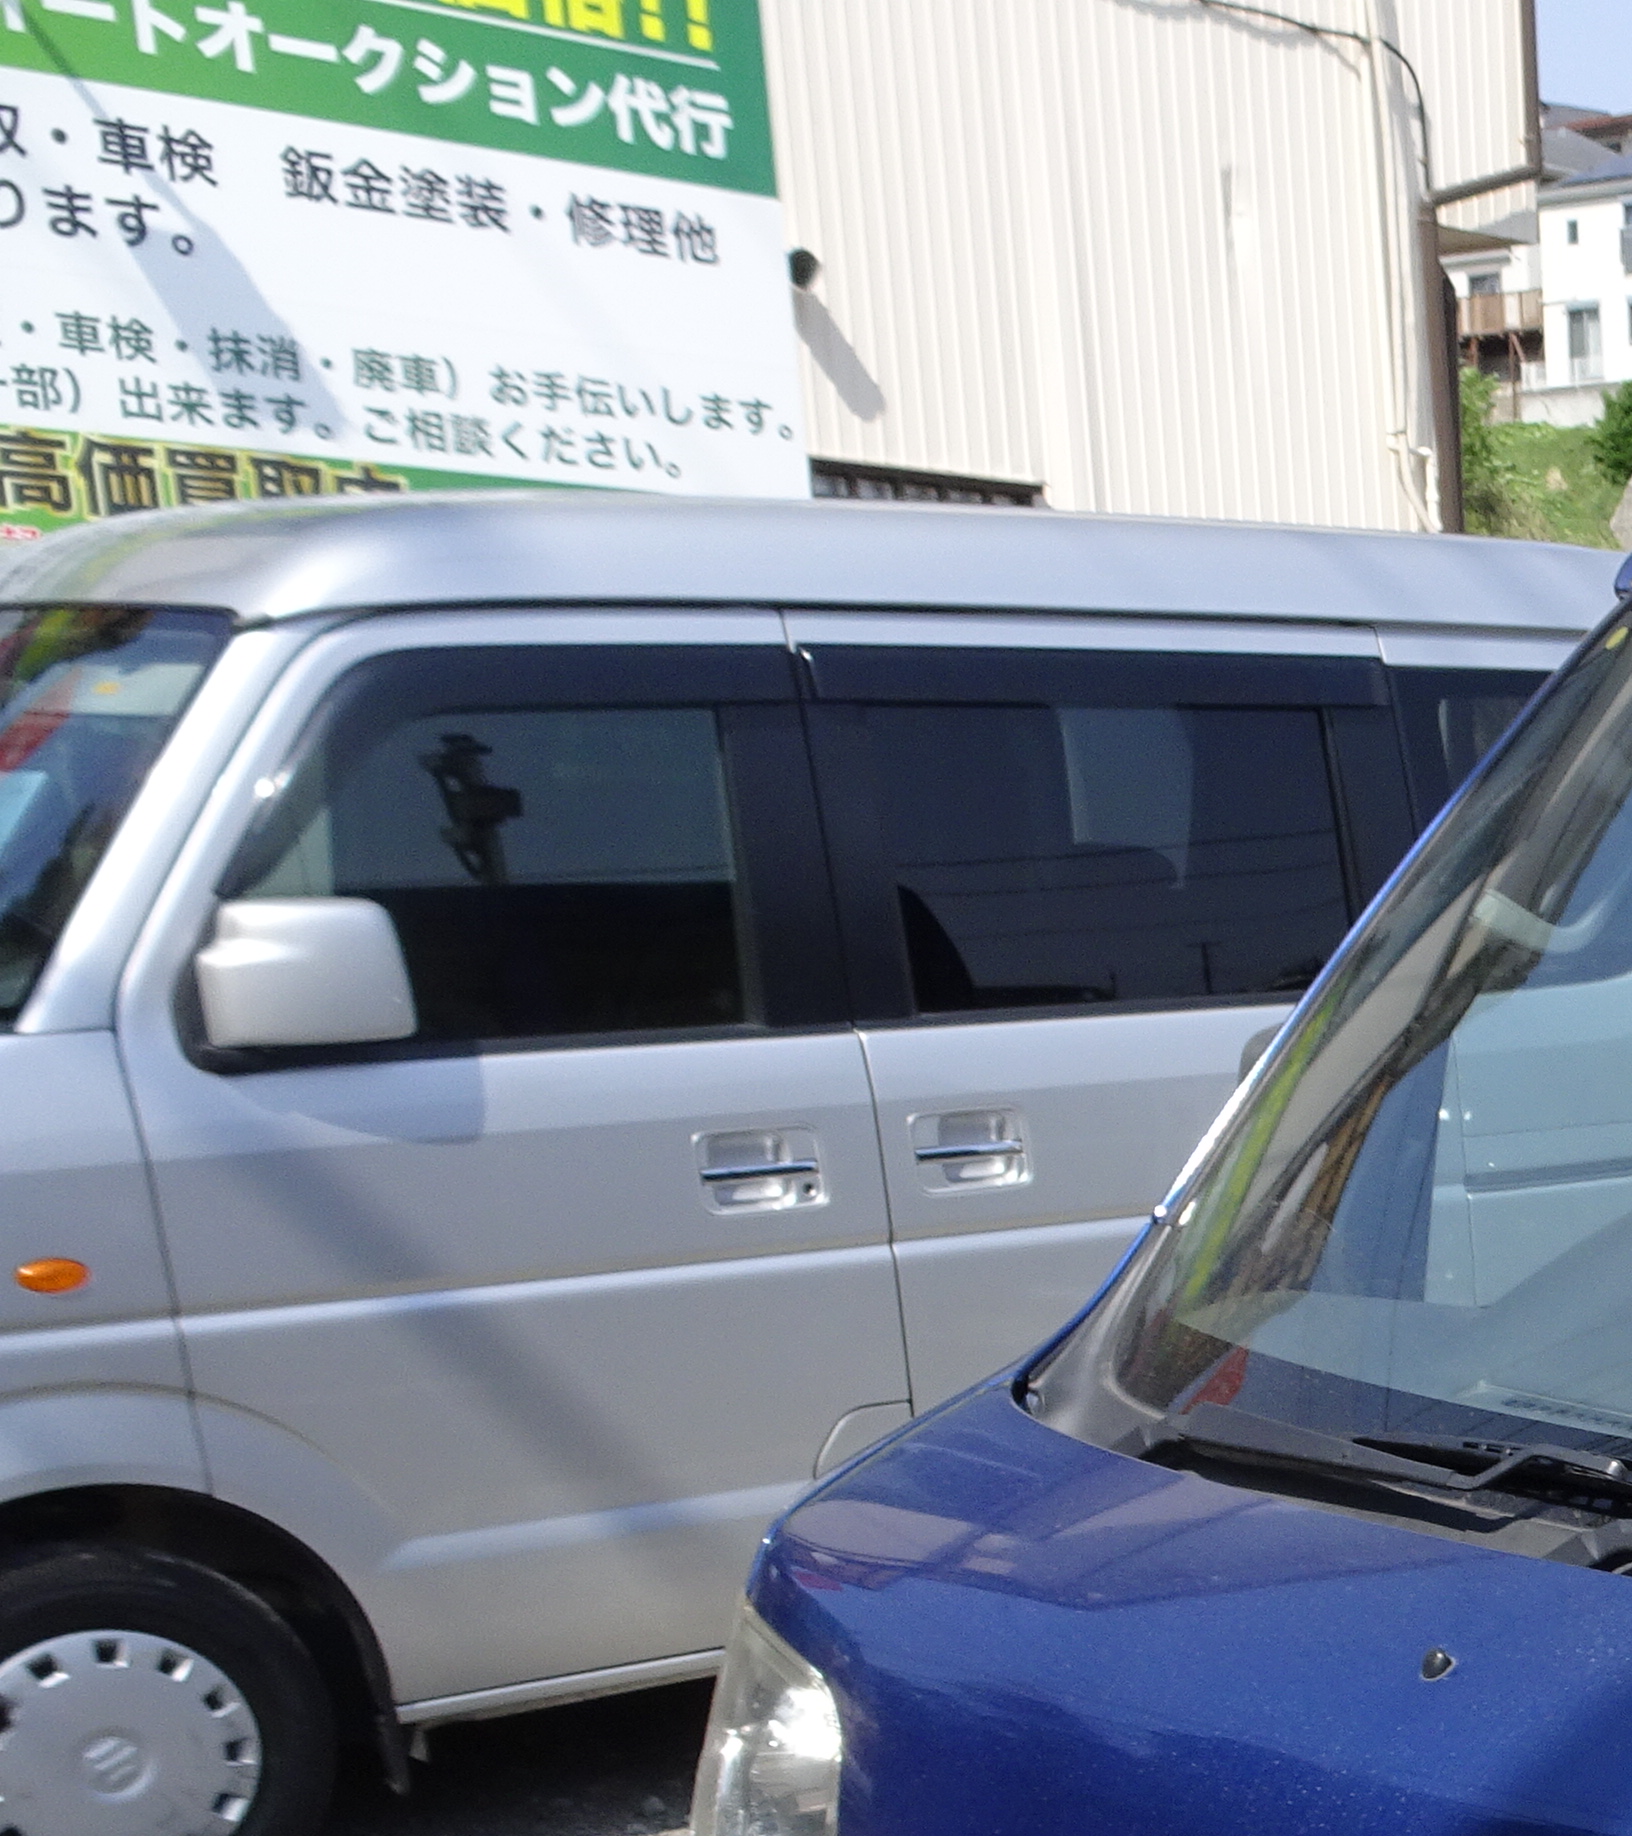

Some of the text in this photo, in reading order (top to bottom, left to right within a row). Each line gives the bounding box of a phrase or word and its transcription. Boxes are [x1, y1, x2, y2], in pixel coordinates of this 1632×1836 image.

[4, 0, 735, 160] ートオークション代行
